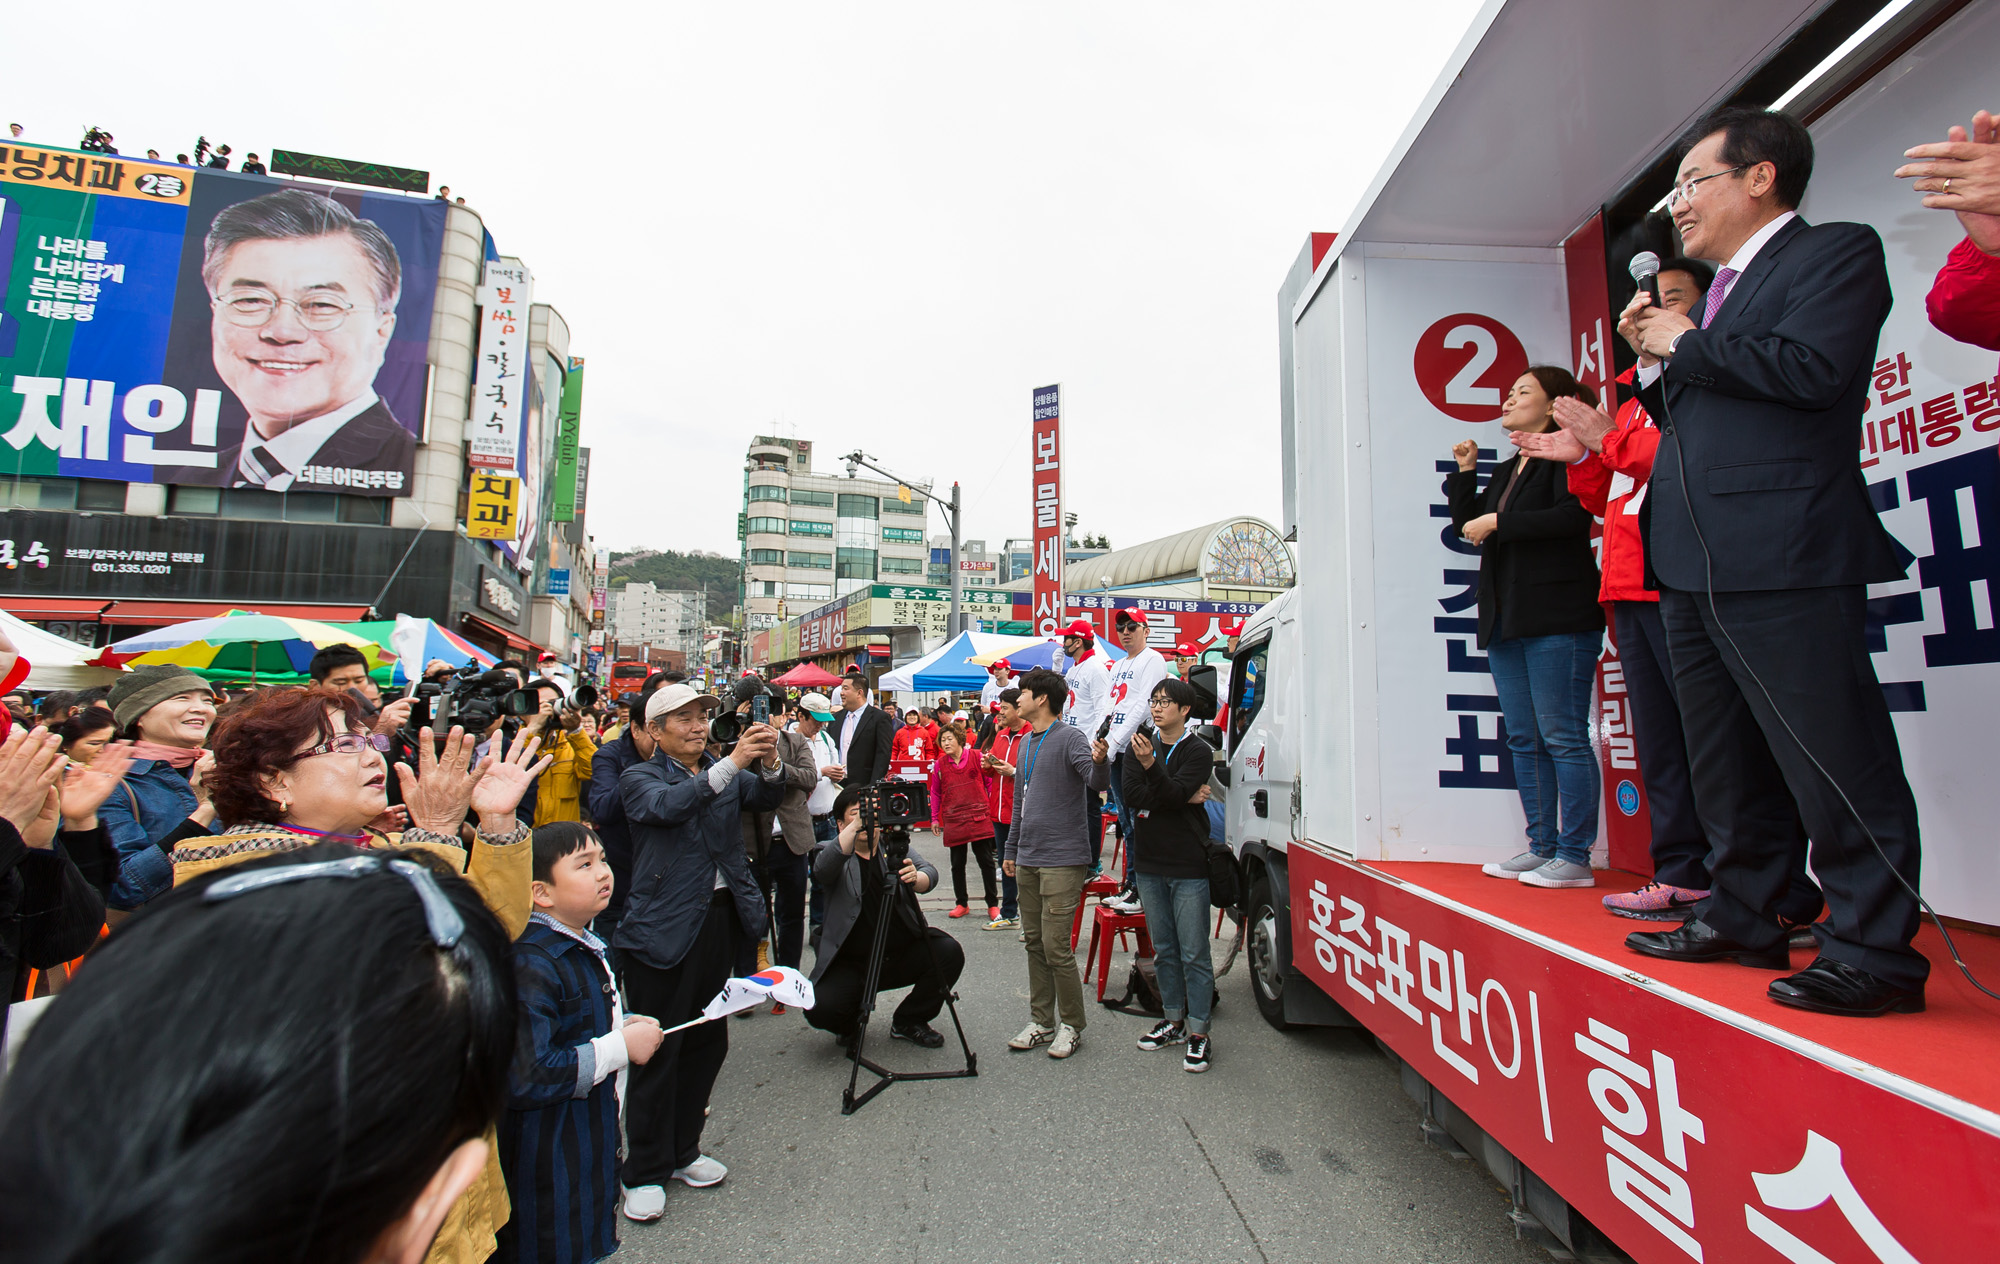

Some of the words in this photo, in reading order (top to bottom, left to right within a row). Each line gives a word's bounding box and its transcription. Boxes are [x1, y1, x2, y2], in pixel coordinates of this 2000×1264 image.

[140, 173, 183, 197] 2층
[37, 235, 108, 261] 나라를
[34, 256, 125, 284] 나라답게
[29, 276, 101, 302] 든든한
[26, 299, 96, 322] 대통령
[1443, 324, 1501, 406] 2
[1865, 351, 1912, 414] 한
[1, 374, 222, 469] 재인
[296, 465, 404, 490] 더불어민주당
[474, 477, 513, 526] 치과
[479, 527, 505, 537] 2F
[1035, 429, 1060, 636] 보물세상
[91, 562, 172, 575] 031.335.0201
[1137, 599, 1198, 613] 할인매장
[800, 610, 845, 653] 보물세상
[1308, 880, 1554, 1144] 홍준표만이
[1575, 1017, 1706, 1264] 할
